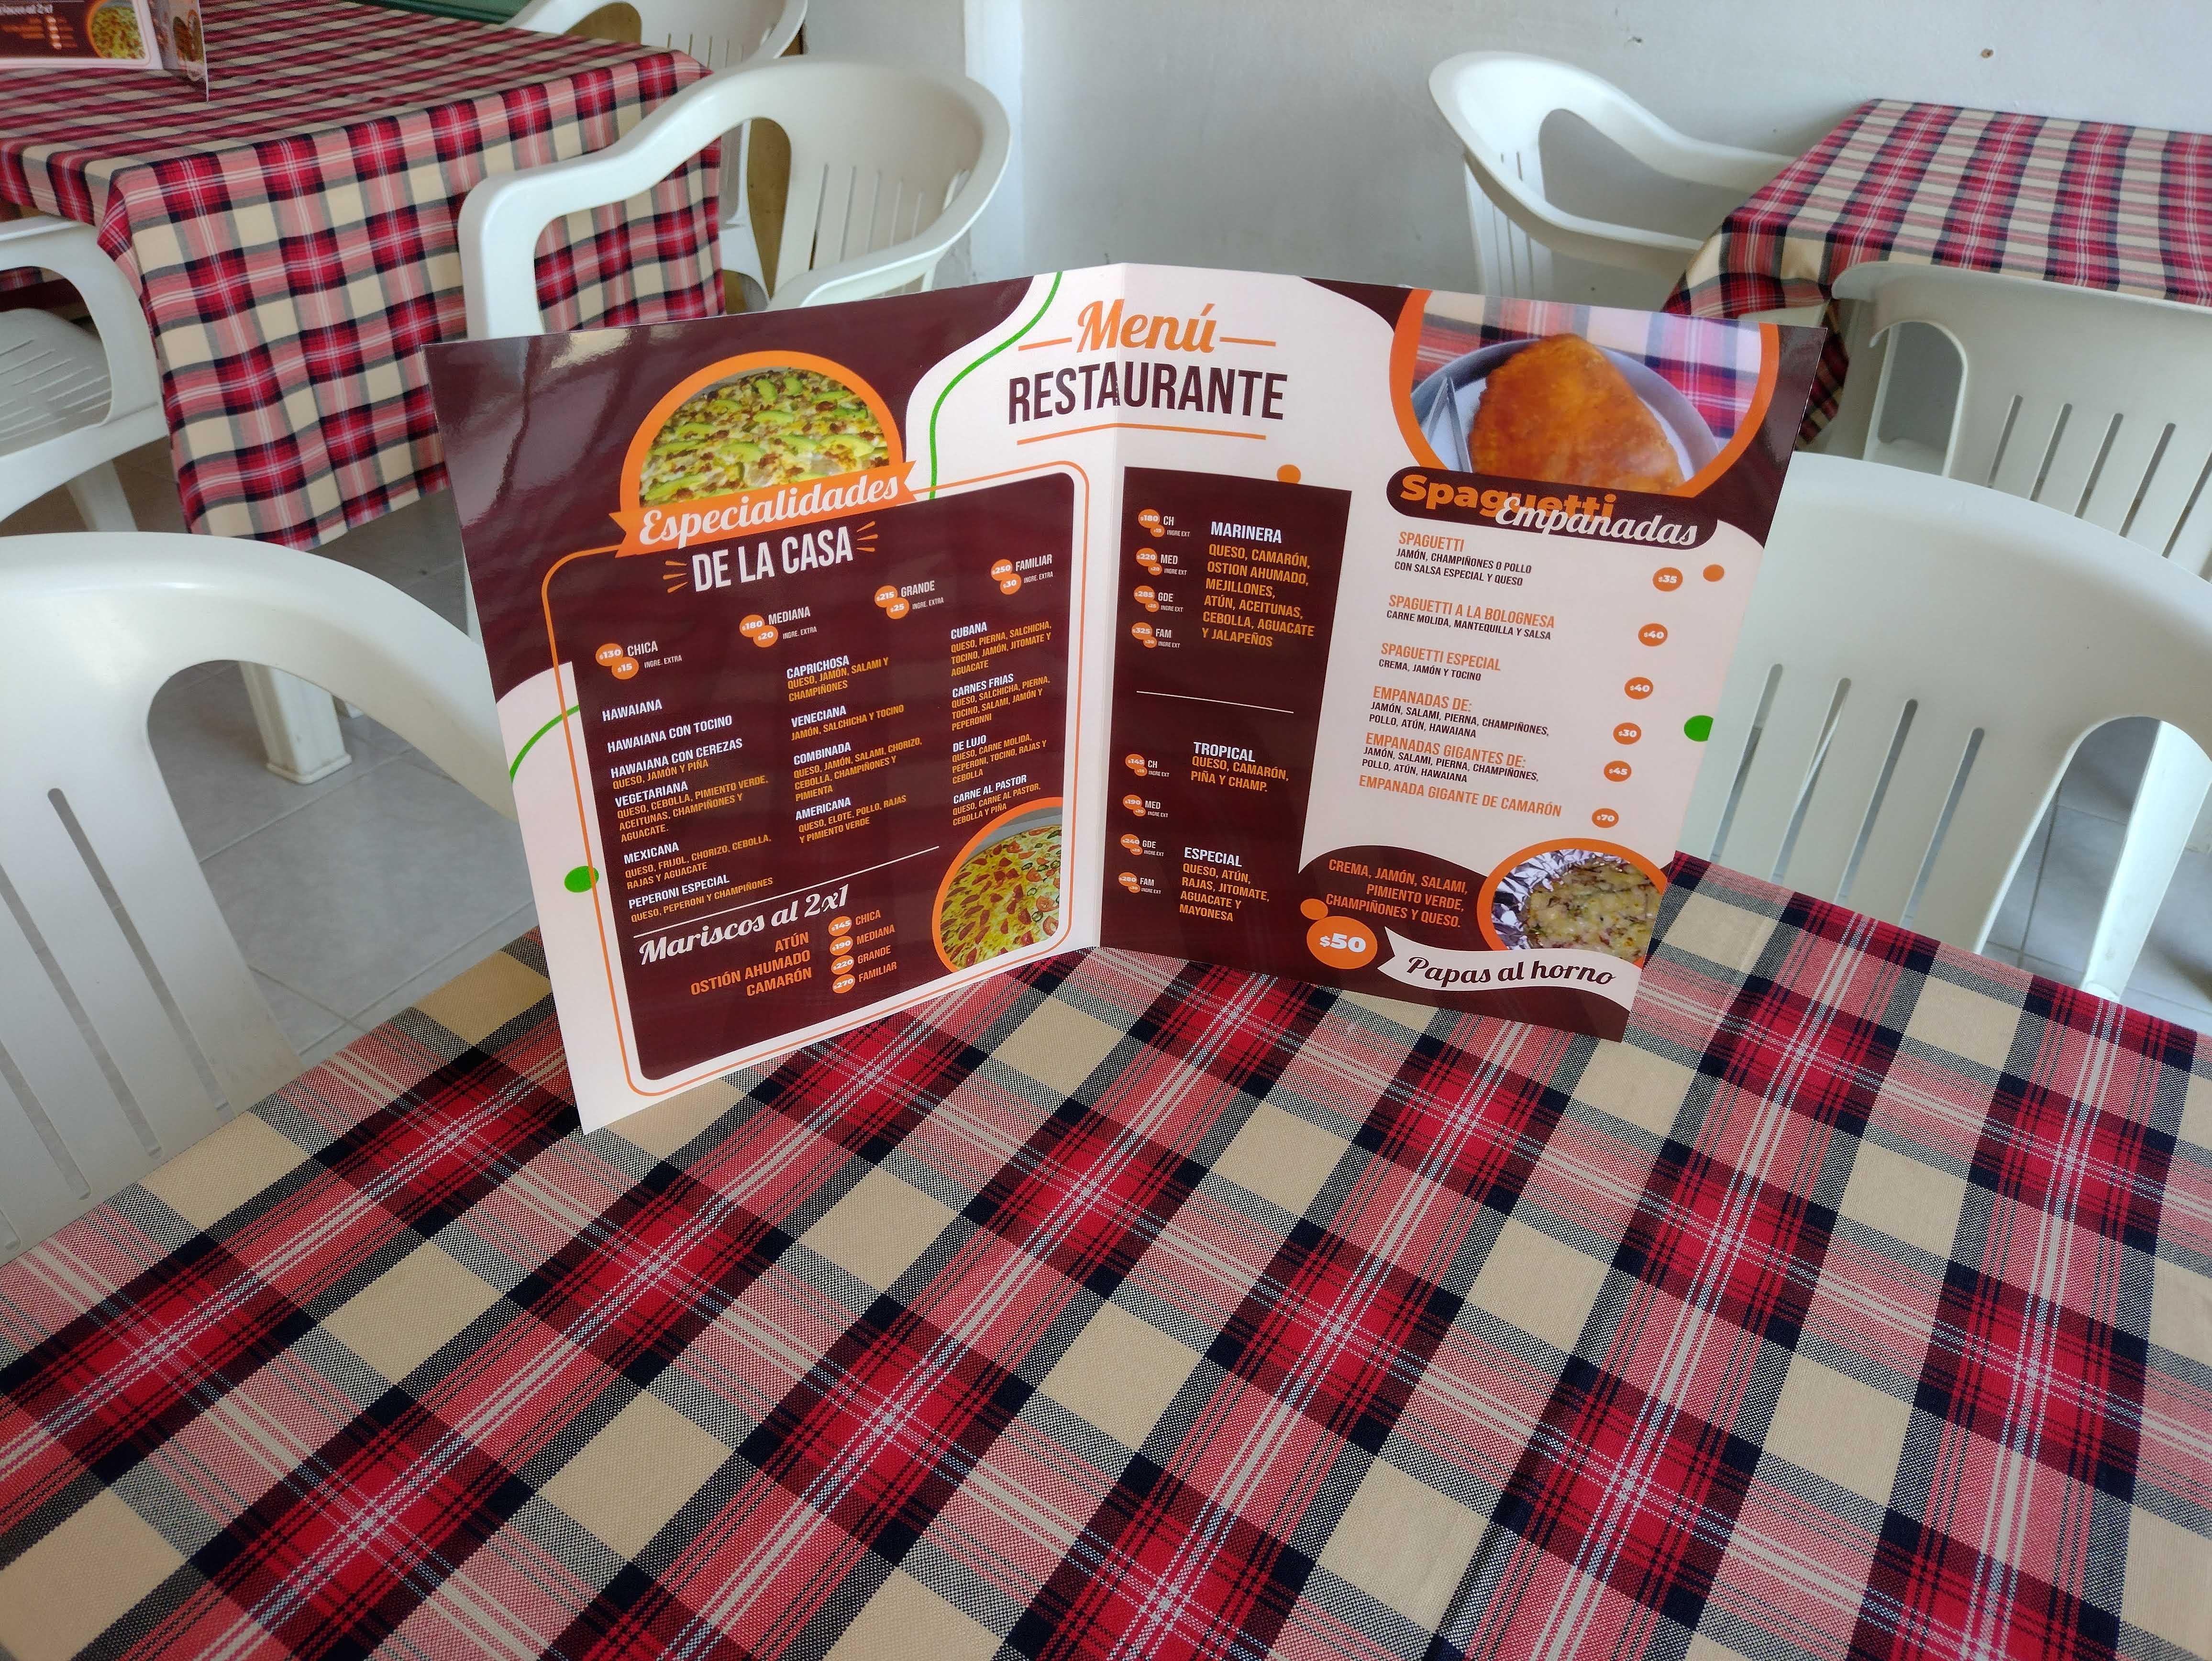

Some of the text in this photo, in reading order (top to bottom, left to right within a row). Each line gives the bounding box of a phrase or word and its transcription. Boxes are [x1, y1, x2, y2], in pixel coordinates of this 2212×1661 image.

[1077, 299, 1216, 353] Menú
[1008, 361, 1287, 424] RESTAURANTE
[639, 476, 899, 549] Especialidades
[1163, 516, 1174, 526] CH
[1495, 497, 1698, 546] Empanadas
[1211, 521, 1282, 543] MARINERA
[1398, 532, 1464, 553] SPAGUETTI
[692, 526, 853, 592] DE LA CASA
[992, 554, 1052, 575] $250 FAMILIAR
[1161, 554, 1178, 564] MED
[1209, 544, 1310, 568] QUESO, CAMARÓN,
[1396, 548, 1532, 574] JAMÓN, CHAMPIÑONES O POLLO
[1207, 561, 1309, 586] OSTION AHUMADO,
[1394, 562, 1523, 586] CON SALSA ESPECIAL Y QUESO
[1658, 575, 1677, 584] $35
[901, 580, 935, 598] GRANDE
[1158, 592, 1173, 602] GDE
[1206, 578, 1275, 598] MEJILLONES,
[741, 606, 811, 631] $180 MEDIANA
[1204, 595, 1303, 619] ATÚN, ACEITUNAS,
[1389, 594, 1554, 628] SPAGUETTI A LA BOLOGNESA
[951, 621, 987, 640] CUBANA
[1156, 629, 1172, 638] FAM
[1203, 611, 1315, 637] CEBOLLA, AGUACATE
[1644, 631, 1664, 639] $40
[757, 631, 774, 641] $20
[1202, 628, 1273, 647] Y JALAPEÑOS
[599, 641, 658, 660] $130 CHICA
[1381, 642, 1501, 671] SPAGUETTI ESPECIAL
[618, 663, 632, 673] $15
[664, 655, 682, 665] EXTRA
[786, 655, 850, 679] CAPRICHOSA
[951, 660, 989, 676] AGUACATE
[789, 680, 848, 702] CHAMPIÑONES
[952, 674, 1014, 698] CARNES FRIAS
[1630, 684, 1650, 692] $40
[602, 699, 662, 721] HAWAIANA
[1373, 686, 1472, 712] EMPANADAS DE:
[791, 706, 846, 728] VENECIANA
[823, 714, 867, 733] SALCHICHA
[876, 704, 904, 719] TOCINO
[951, 713, 992, 731] PEPERONNI
[607, 715, 732, 753] HAWAIANA CON TOCINO
[953, 735, 987, 753] DE LUJO
[610, 738, 743, 778] HAWAIANA CON CEREZAS
[794, 742, 852, 765] COMBINADA
[1193, 742, 1256, 762] TROPICAL
[1366, 732, 1526, 768] EMPANADAS GIGANTES DE:
[1148, 760, 1157, 768] CH
[1192, 756, 1289, 781] QUESO, CAMARÓN,
[952, 769, 983, 784] CEBOLLA
[1191, 771, 1268, 792] PIÑA Y CHAMP.
[615, 781, 688, 808] VEGETARIANA
[953, 775, 1027, 804] CARNE AL PASTOR
[1359, 775, 1562, 817] EMPANADA GIGANTE DE CAMARÓN
[796, 797, 851, 820] AMERICANA
[1145, 800, 1161, 809] MED
[623, 842, 679, 864] MEXICANA
[1142, 840, 1156, 848] GDE
[1184, 847, 1242, 867] ESPECIAL
[1140, 878, 1154, 886] FAM
[1183, 864, 1251, 885] QUESO, ATÚN,
[1328, 859, 1468, 895] CREMA, JAMÓN, SALAMI,
[629, 875, 730, 909] PEPERONI ESPECIAL
[1180, 891, 1241, 909] AGUACATE Y
[1182, 877, 1270, 902] RAJAS, JITOMATE,
[1367, 884, 1464, 912] PIMIENTO VERDE,
[831, 909, 881, 933] $145 CHICA
[1179, 904, 1233, 921] MAYONESA
[1326, 894, 1460, 928] CHAMPIÑONES Y QUESO.
[639, 884, 849, 965] Mariscos al 2x1
[775, 932, 809, 952] ATÚN
[831, 925, 896, 952] $190 MEDIANA
[1319, 933, 1367, 952] $50
[833, 945, 891, 971] $220 GRANDE
[690, 950, 810, 996] OSTIÓN AHUMADO
[747, 967, 812, 997] CAMARÓN
[834, 961, 897, 990] $270 FAMILIAR
[1406, 956, 1616, 987] Papas al horno
